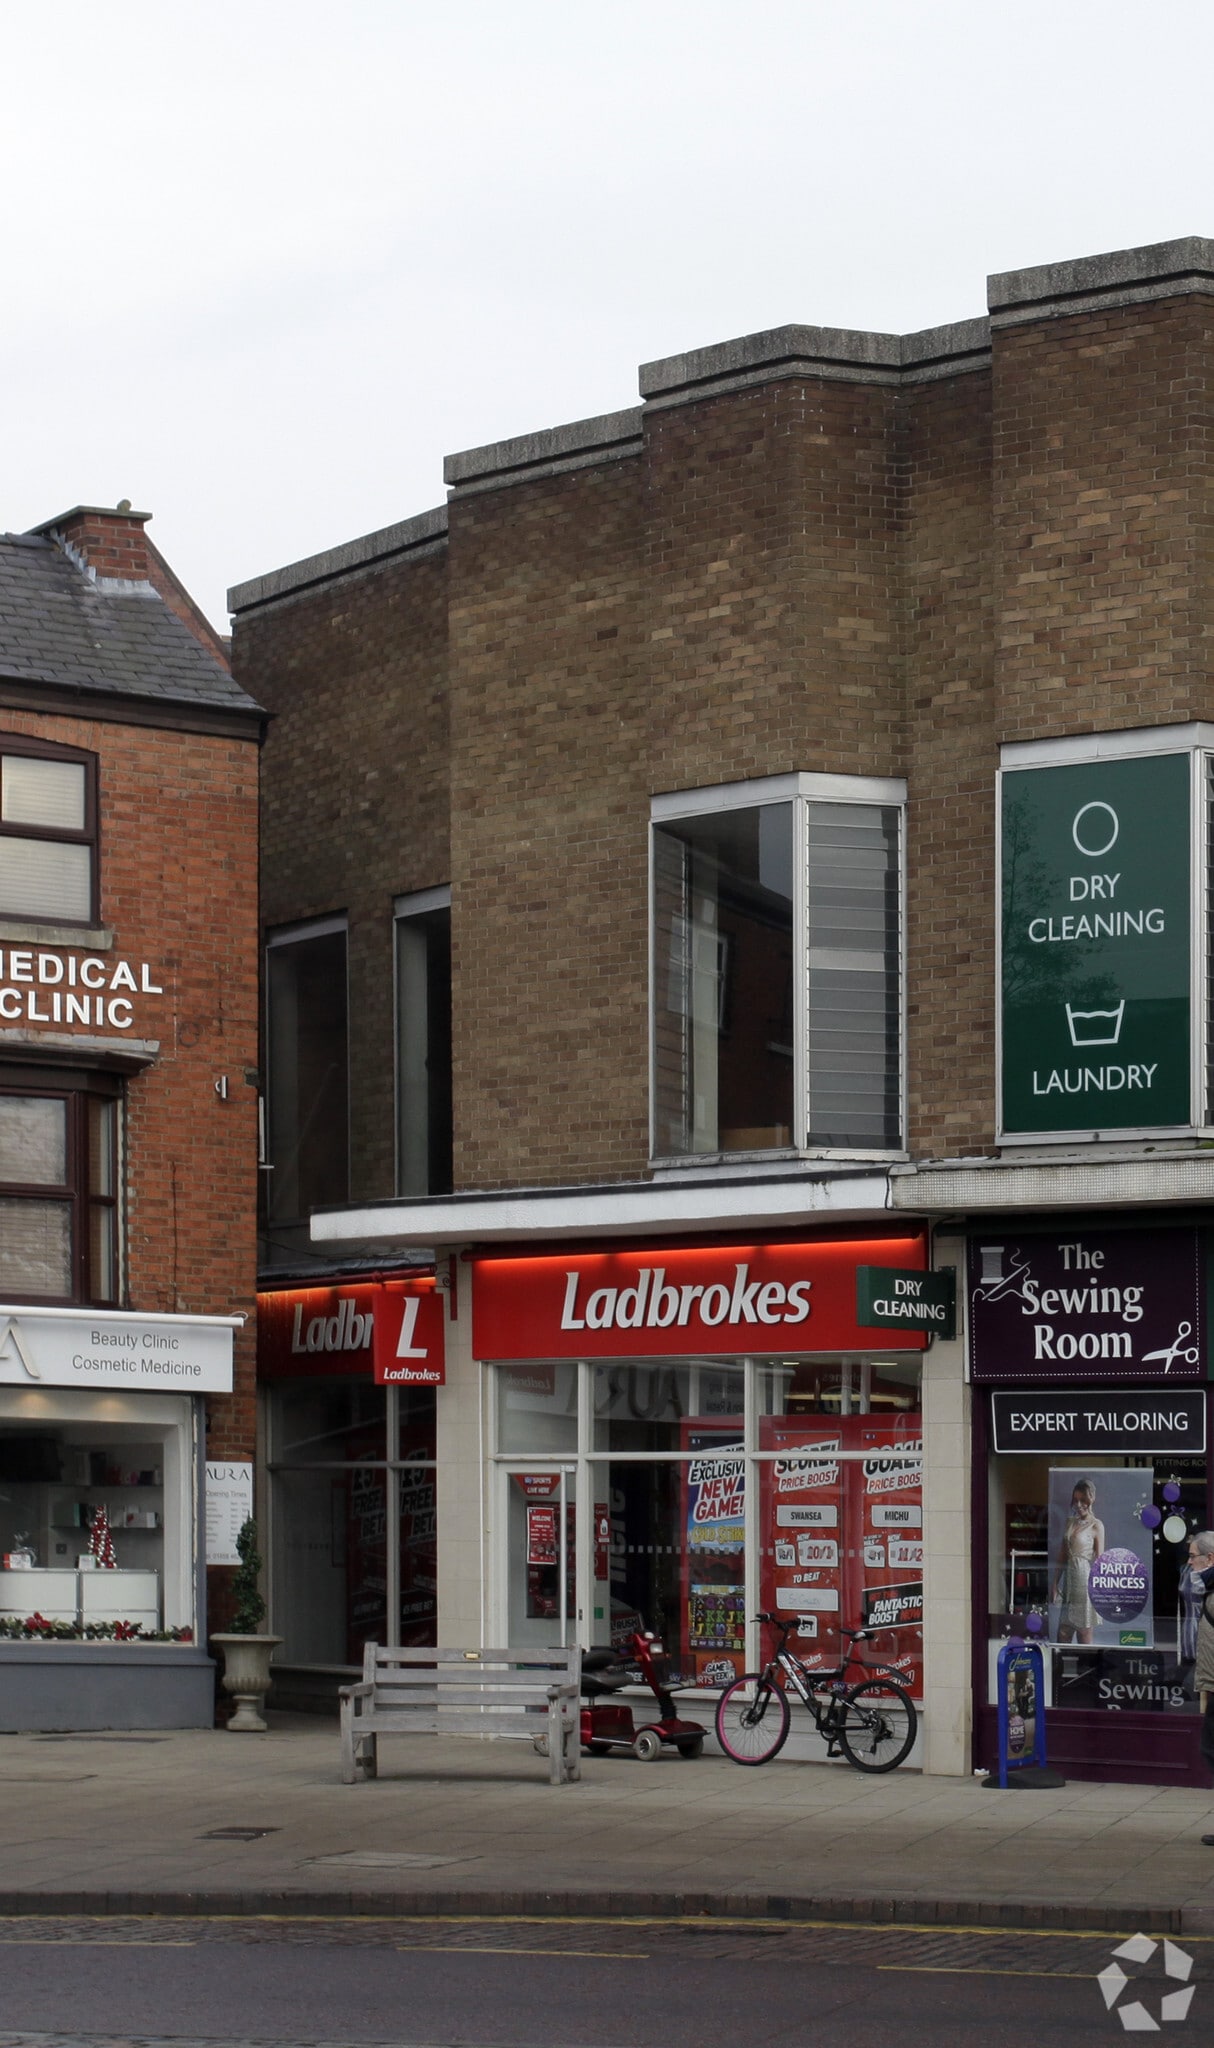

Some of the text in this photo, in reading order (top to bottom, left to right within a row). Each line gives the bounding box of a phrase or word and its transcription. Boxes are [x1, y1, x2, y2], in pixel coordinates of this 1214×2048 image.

[1069, 873, 1121, 901] DRY
[1028, 909, 1165, 942] CLEANING
[0, 949, 163, 994] EDICAL
[0, 988, 133, 1029] CLINIC
[1033, 1063, 1158, 1095] LAUNDRY
[1058, 1243, 1105, 1270] The
[561, 1264, 811, 1330] Ladbrokes
[895, 1279, 923, 1296] DRY
[873, 1299, 946, 1320] CLEANING
[1022, 1277, 1144, 1322] Sewing
[292, 1299, 374, 1353] Ladbr
[396, 1297, 428, 1358] L
[91, 1331, 179, 1350] Beauty Clinic
[1034, 1325, 1133, 1360] Room
[72, 1355, 201, 1376] Cosmetic Medicine
[383, 1366, 440, 1381] Ladbrokes
[1010, 1412, 1188, 1431] EXPERT TAILORING
[701, 1477, 737, 1500] NEW
[781, 1470, 836, 1490] PRICE BOOST
[869, 1479, 894, 1490] PRICE
[353, 1489, 381, 1514] FREE
[402, 1485, 432, 1513] FREE
[695, 1495, 745, 1520] GAME!
[413, 1512, 434, 1535] BET
[790, 1511, 822, 1520] SWANSEA
[884, 1511, 909, 1520] MICHU
[793, 1572, 820, 1583] TO BEAT
[1100, 1562, 1137, 1575] PARTY
[1092, 1576, 1145, 1589] PRINCESS
[874, 1595, 922, 1613] FANTASTIC
[868, 1610, 898, 1625] BOOST
[1126, 1660, 1158, 1675] The
[1099, 1679, 1184, 1707] Sewing
